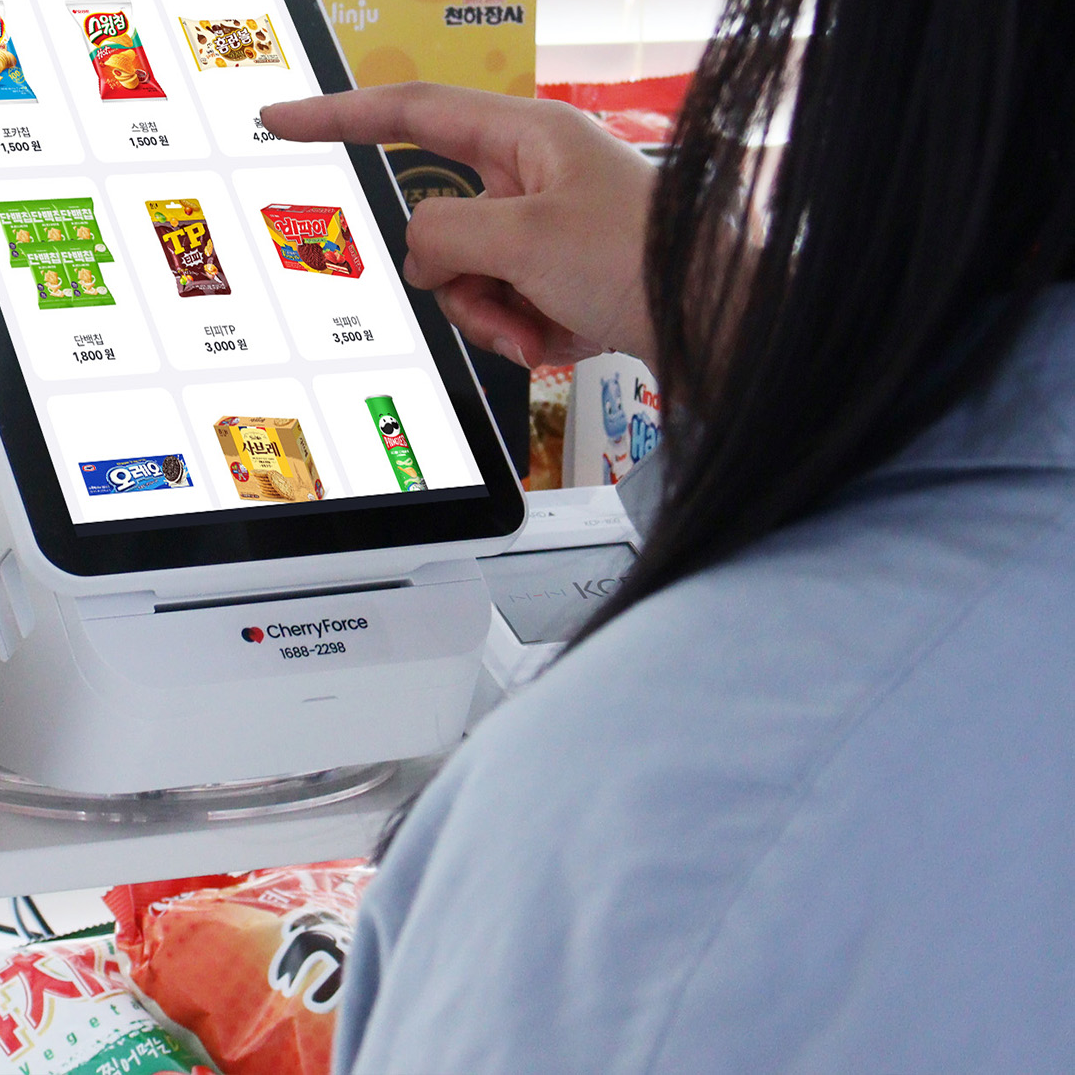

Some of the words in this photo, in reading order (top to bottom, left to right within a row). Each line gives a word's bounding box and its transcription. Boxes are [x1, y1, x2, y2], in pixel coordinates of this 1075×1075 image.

[444, 5, 525, 26] 천하장사
[88, 13, 127, 44] 스윙칩
[213, 27, 254, 55] 홈런볼
[2, 126, 31, 139] 포카칩
[131, 121, 158, 134] 스윙칩
[0, 141, 30, 154] 1,500
[31, 140, 42, 152] 원
[129, 136, 158, 148] 1,500
[159, 135, 170, 147] 원
[60, 208, 94, 222] 단백칩
[162, 222, 206, 255] TP
[273, 217, 328, 246] 빅파이
[27, 252, 62, 266] 단백칩
[61, 250, 96, 264] 단백칩
[332, 315, 361, 328] 빅파이
[204, 325, 236, 338] 티피TP
[332, 331, 362, 344] 3,500
[363, 329, 375, 342] 원
[73, 333, 103, 347] 단백칩
[204, 341, 235, 354] 3,000
[237, 339, 249, 351] 원
[72, 350, 103, 363] 1,800
[104, 348, 116, 361] 원
[242, 440, 281, 458] 사브레
[109, 462, 164, 492] 오레오
[266, 617, 369, 639] CherryForce
[279, 641, 347, 660] 1688-2298
